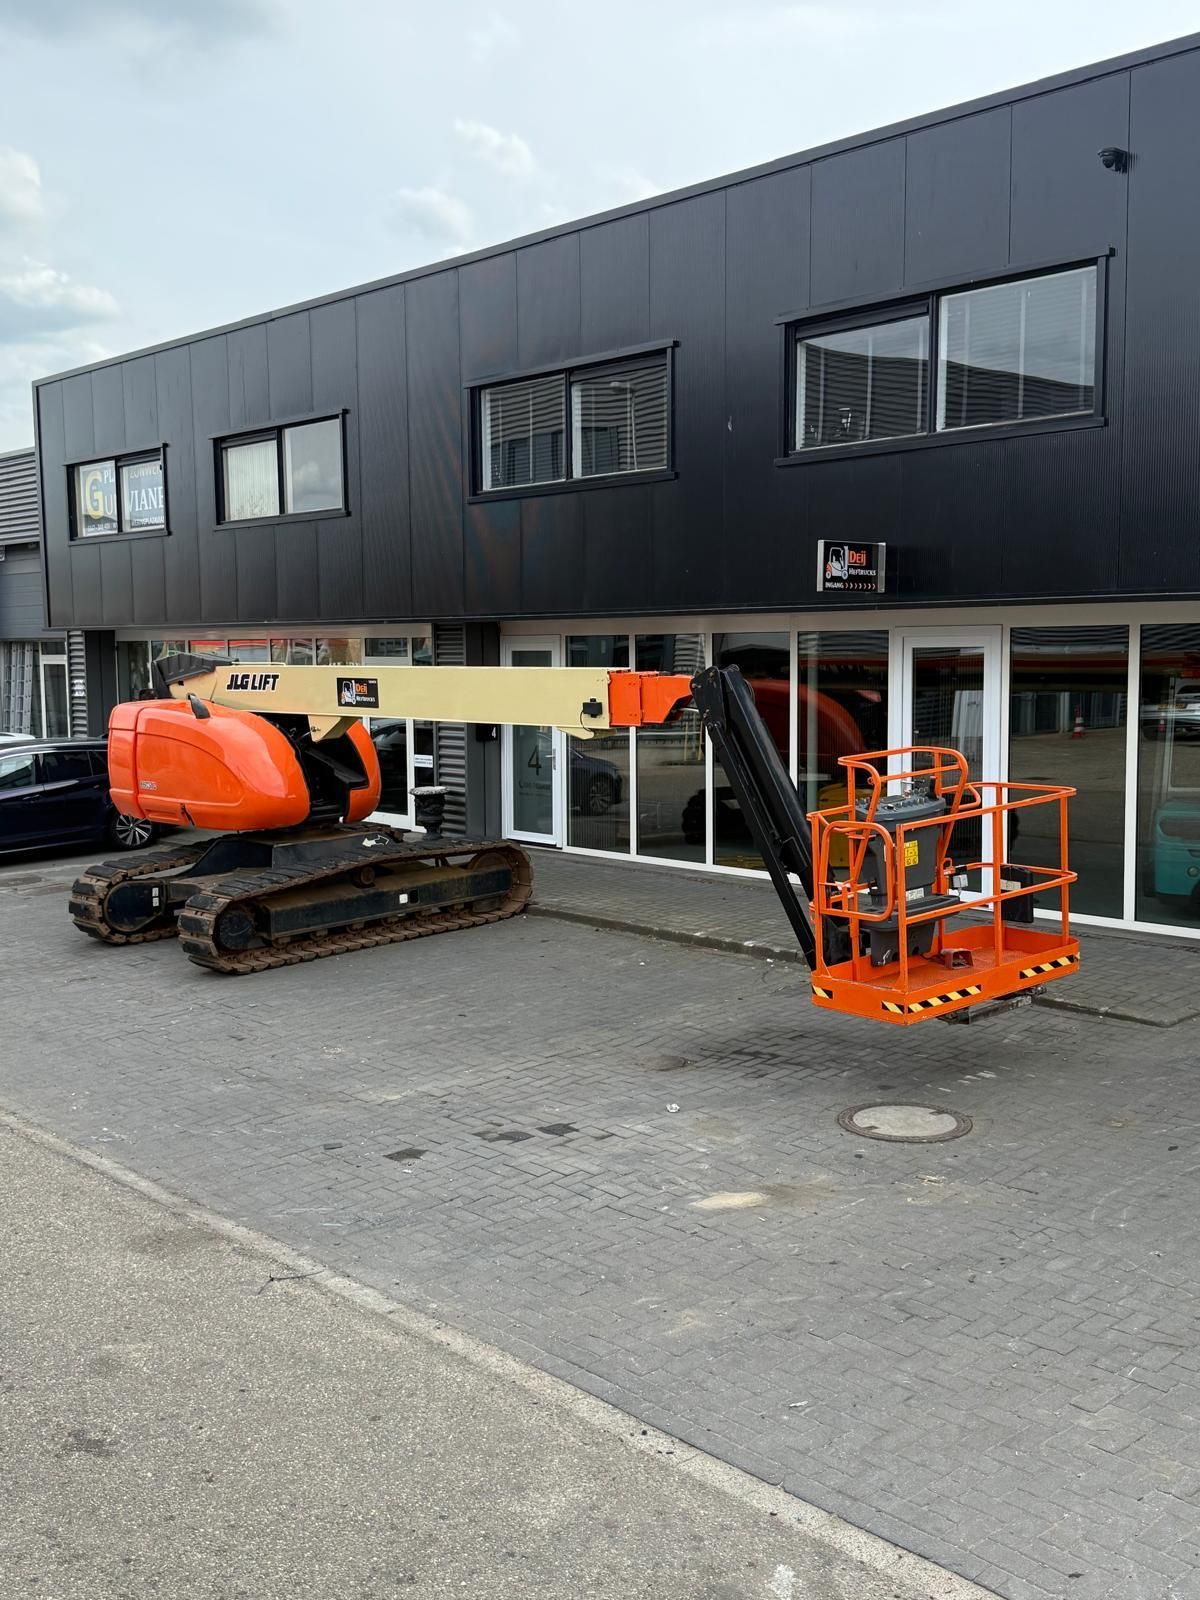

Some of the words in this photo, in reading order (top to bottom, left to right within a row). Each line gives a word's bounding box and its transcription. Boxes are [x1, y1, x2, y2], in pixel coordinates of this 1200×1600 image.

[825, 581, 844, 589] INGANG
[226, 673, 250, 691] JLG
[250, 673, 280, 692] LIFT
[491, 726, 497, 738] 4
[527, 744, 542, 776] 4
